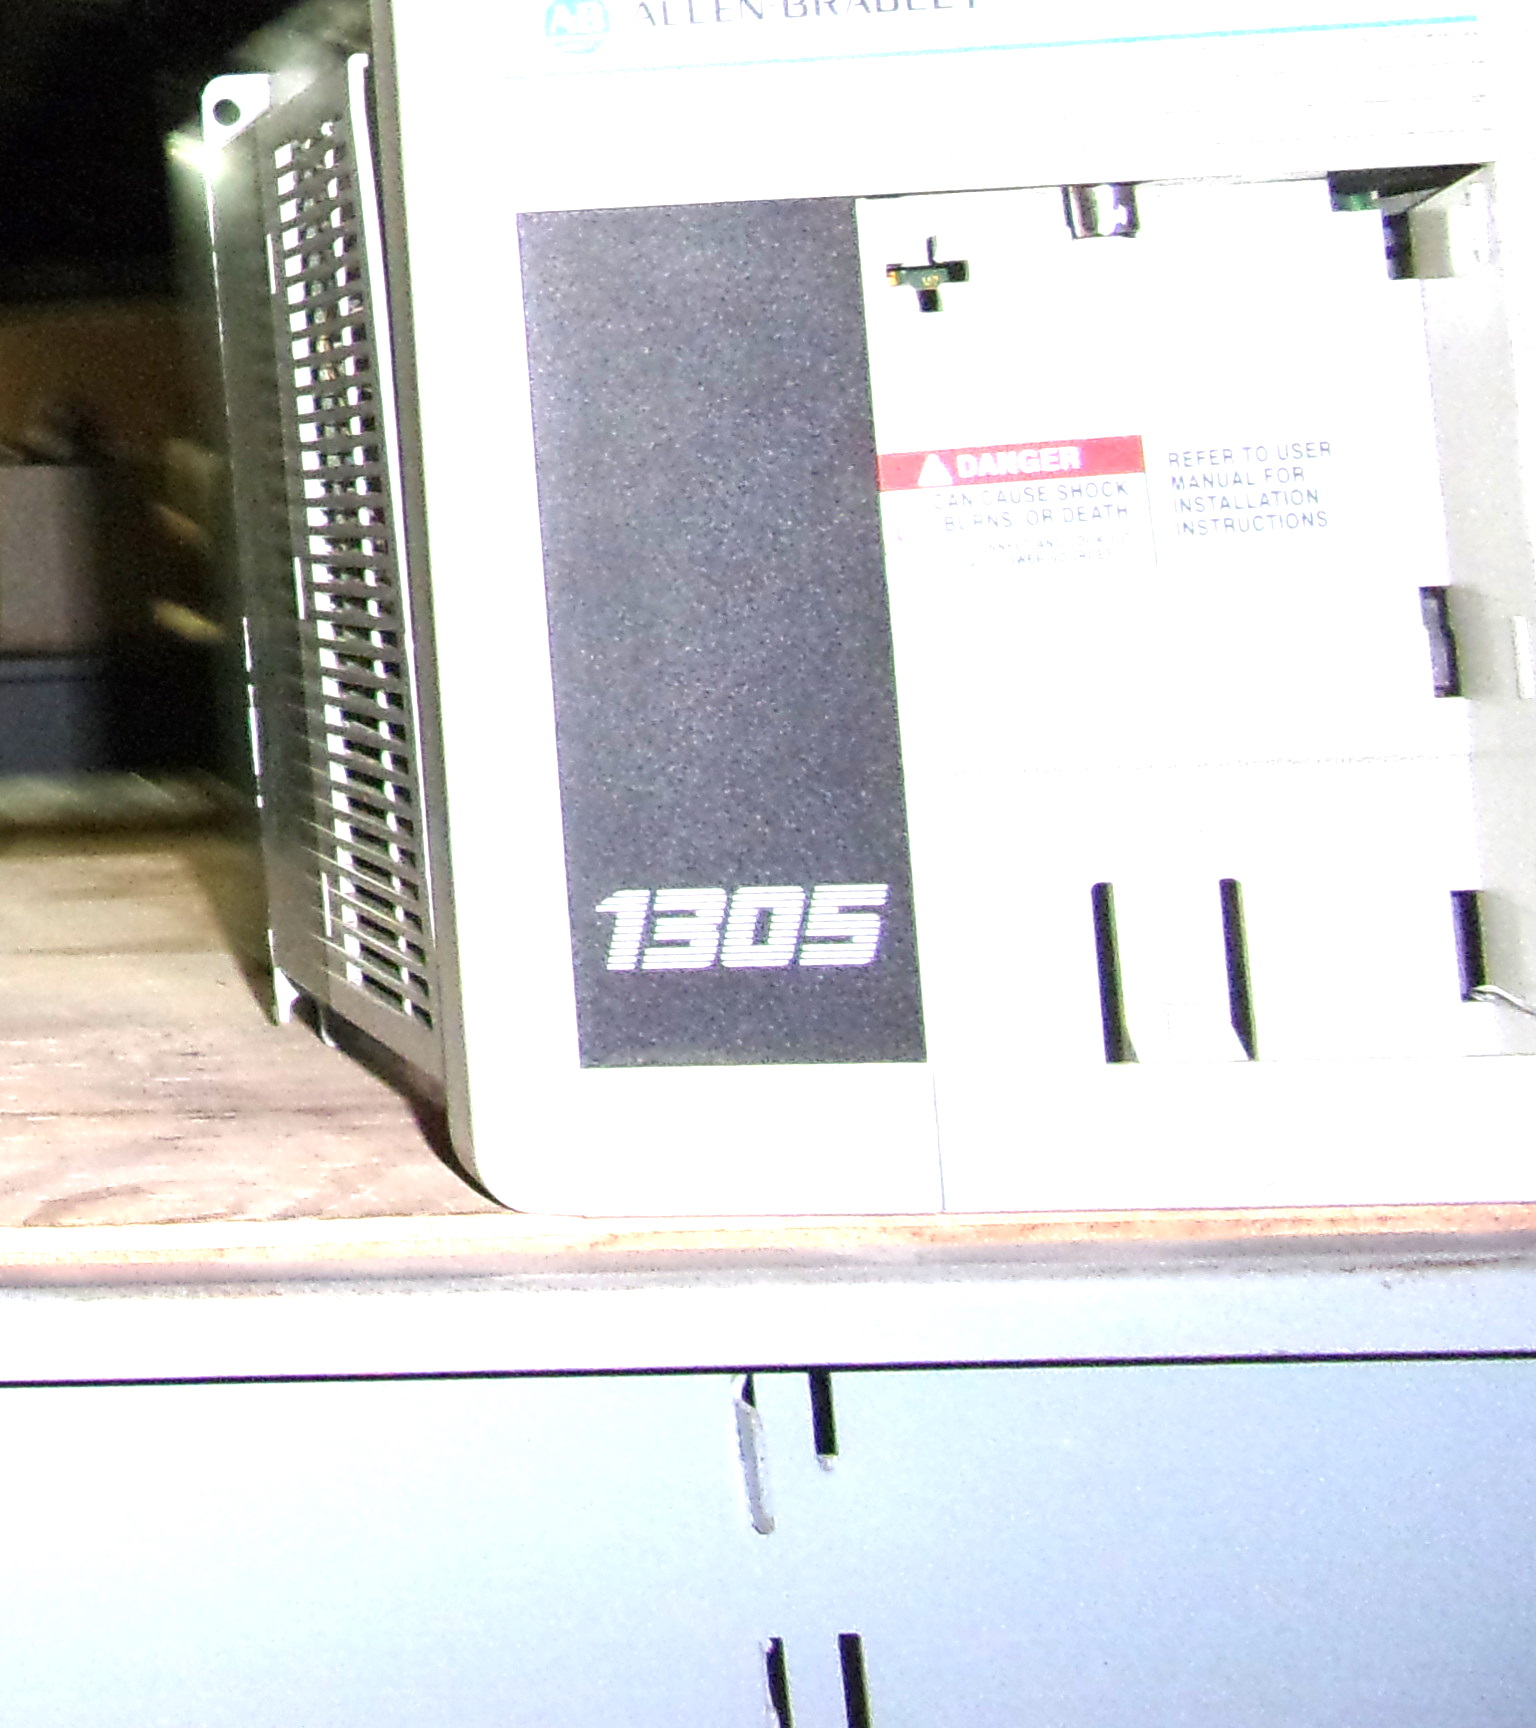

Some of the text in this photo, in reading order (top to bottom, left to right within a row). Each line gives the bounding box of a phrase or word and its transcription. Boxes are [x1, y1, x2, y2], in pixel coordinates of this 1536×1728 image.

[955, 445, 1082, 479] DANGER
[1168, 440, 1332, 468] REFER TO USER
[1171, 466, 1305, 491] MANUAL FOR
[982, 485, 1049, 506] CAUSE
[1057, 480, 1129, 501] SHOCK
[1174, 488, 1320, 513] INSTALLATION
[1026, 508, 1054, 526] OR
[1062, 503, 1129, 523] DEATH
[1176, 510, 1329, 536] INSTRUCTIONS
[594, 883, 890, 971] 1305
